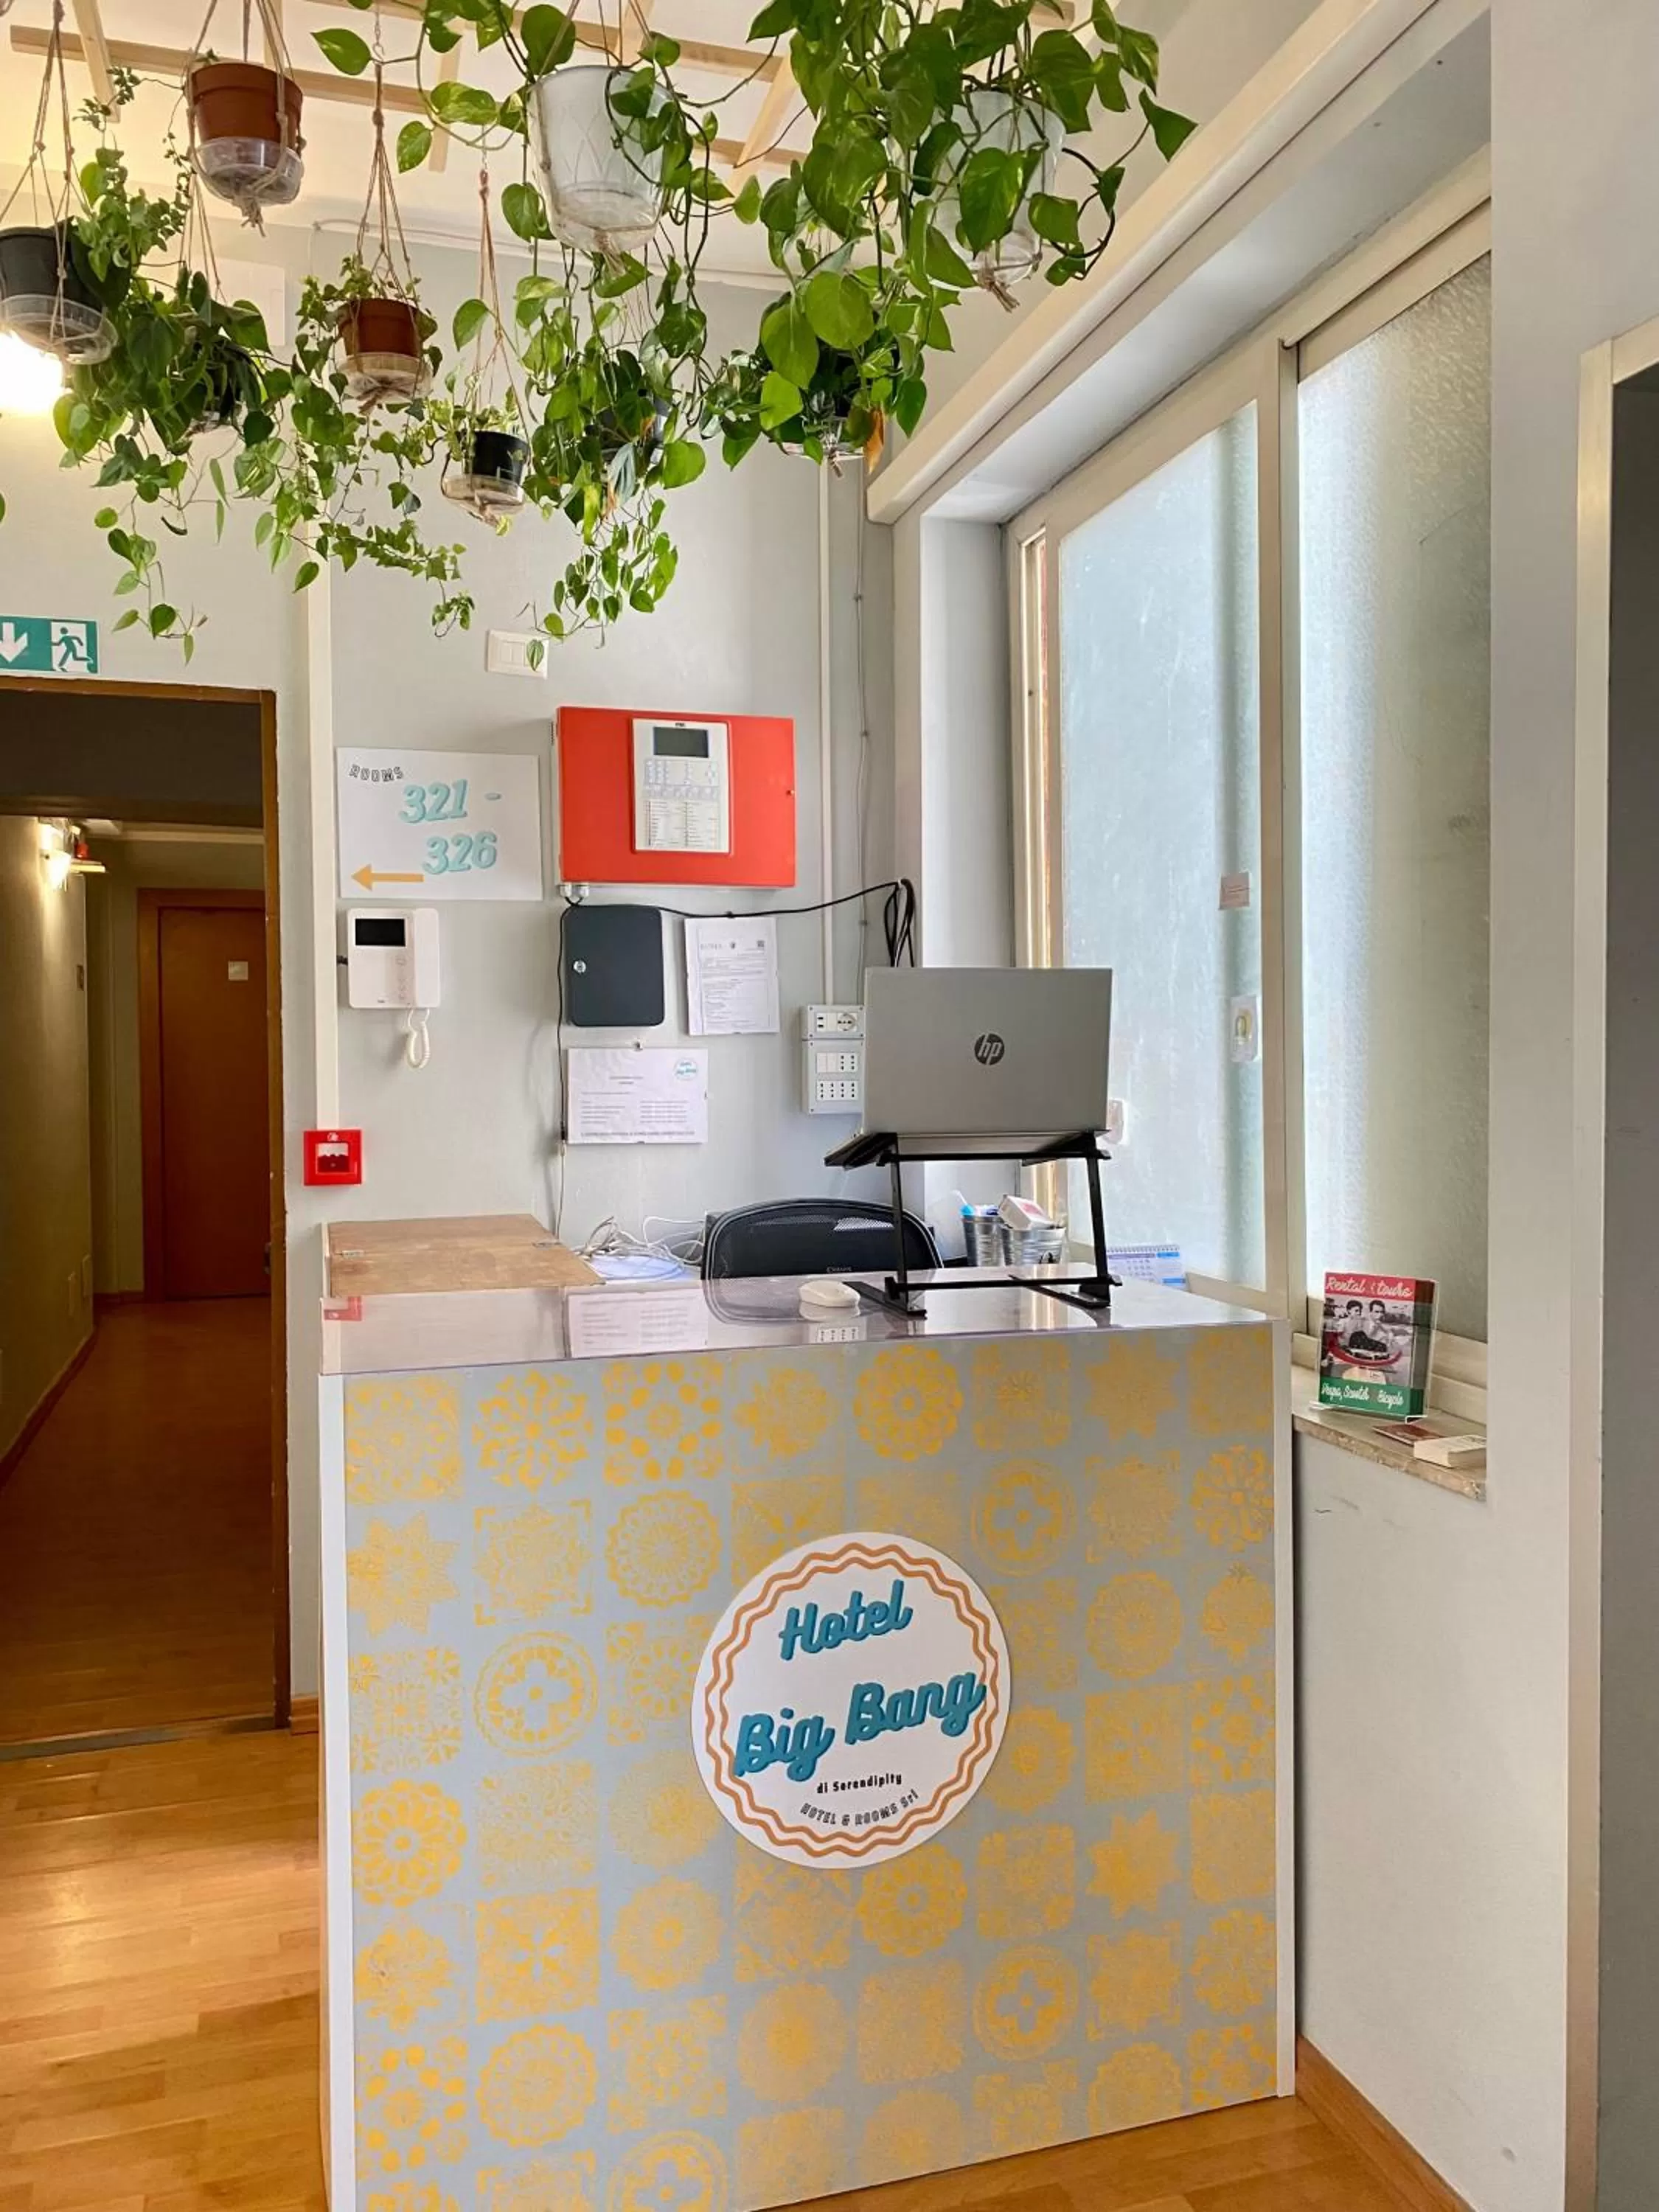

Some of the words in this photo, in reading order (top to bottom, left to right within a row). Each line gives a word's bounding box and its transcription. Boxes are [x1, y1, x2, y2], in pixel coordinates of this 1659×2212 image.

[349, 764, 403, 782] ROOMS
[399, 779, 467, 824] 321
[422, 831, 498, 875] 326
[976, 1032, 1004, 1065] hp
[779, 1579, 914, 1661] Hotel
[733, 1708, 835, 1781] Big
[844, 1672, 987, 1745] Bang
[816, 1781, 828, 1794] di
[832, 1773, 902, 1792] Serendipity
[800, 1802, 836, 1825] HOTEL
[855, 1803, 899, 1826] ROOMS
[900, 1788, 919, 1808] Srl
